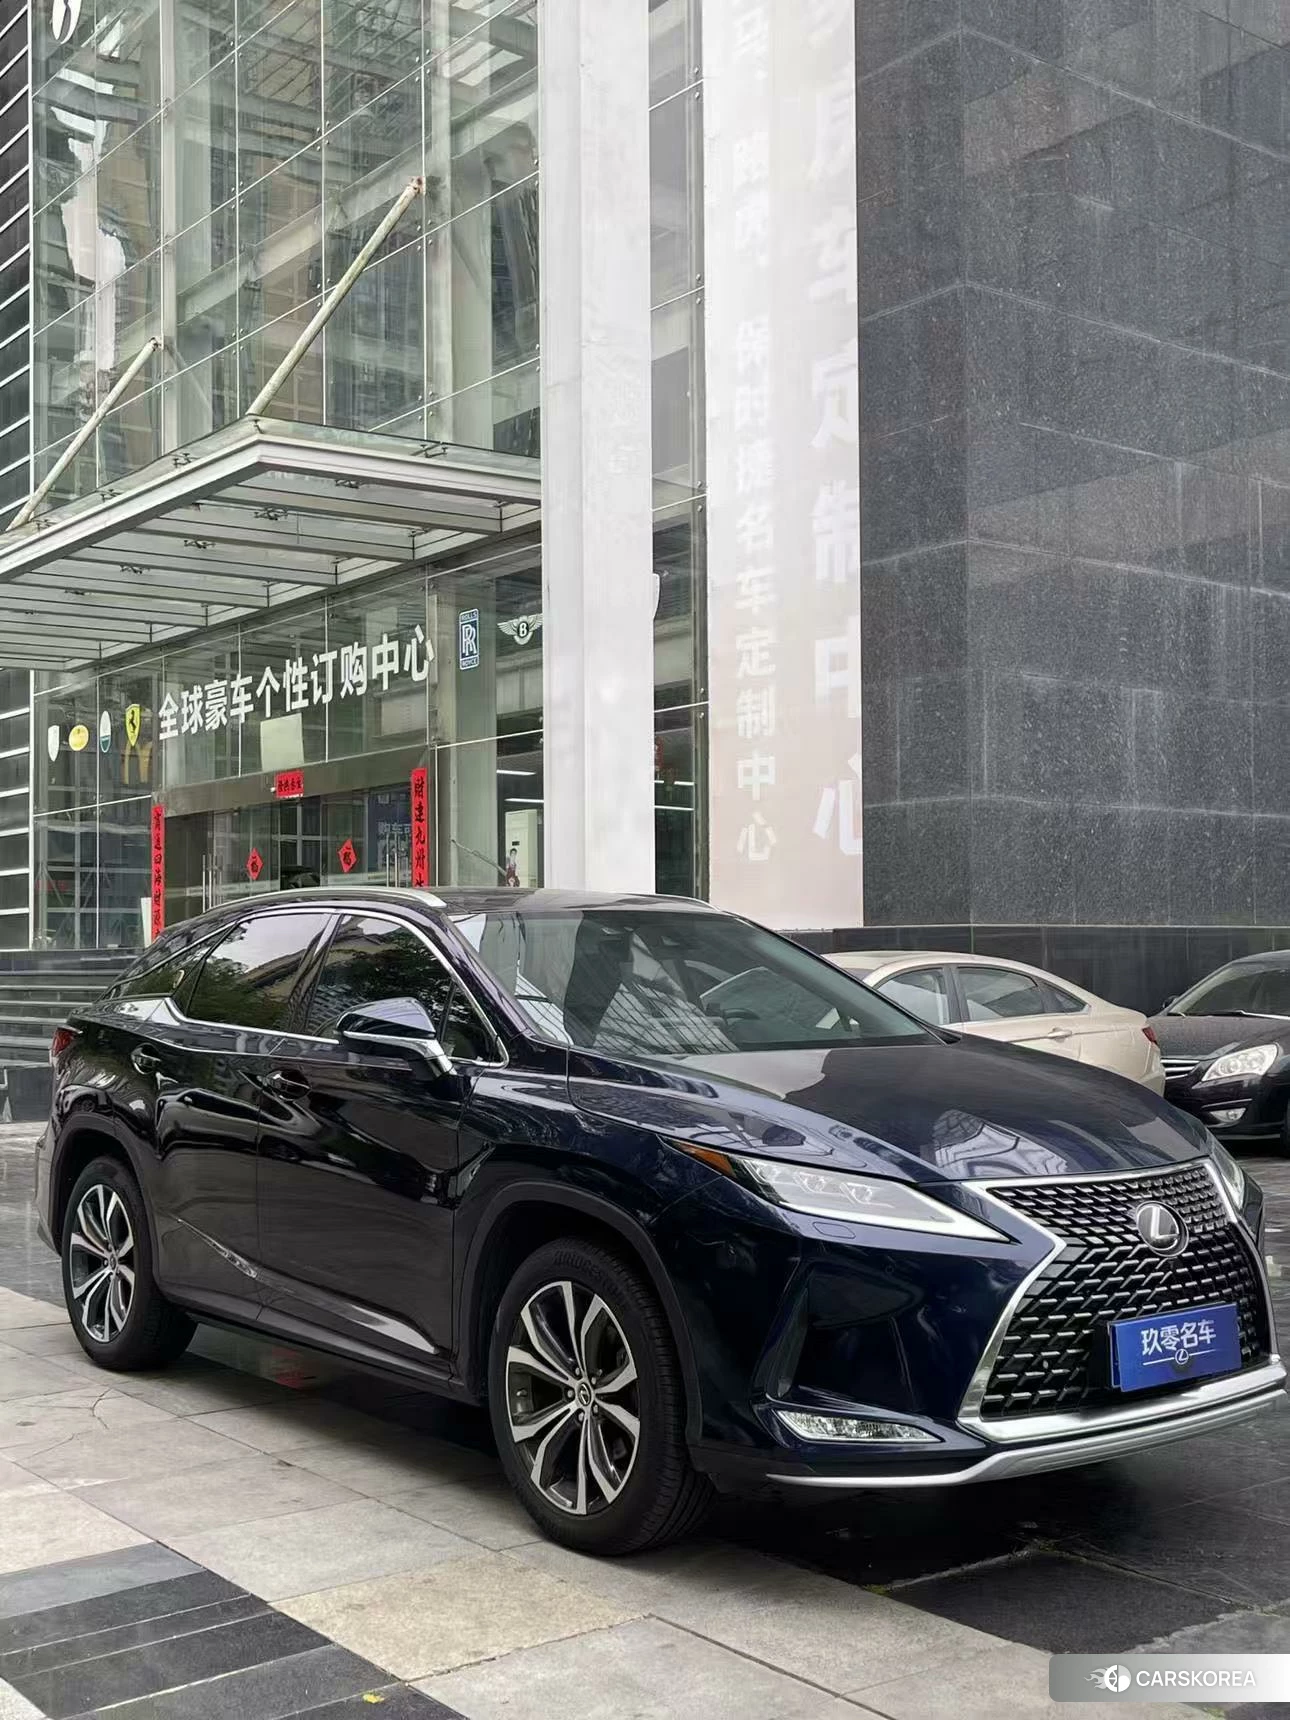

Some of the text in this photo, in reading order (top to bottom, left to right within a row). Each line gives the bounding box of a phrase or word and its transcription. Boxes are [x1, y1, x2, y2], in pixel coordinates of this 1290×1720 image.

[158, 624, 435, 740] 全球豪车个性订购中心
[1140, 1319, 1216, 1356] 玖零名车
